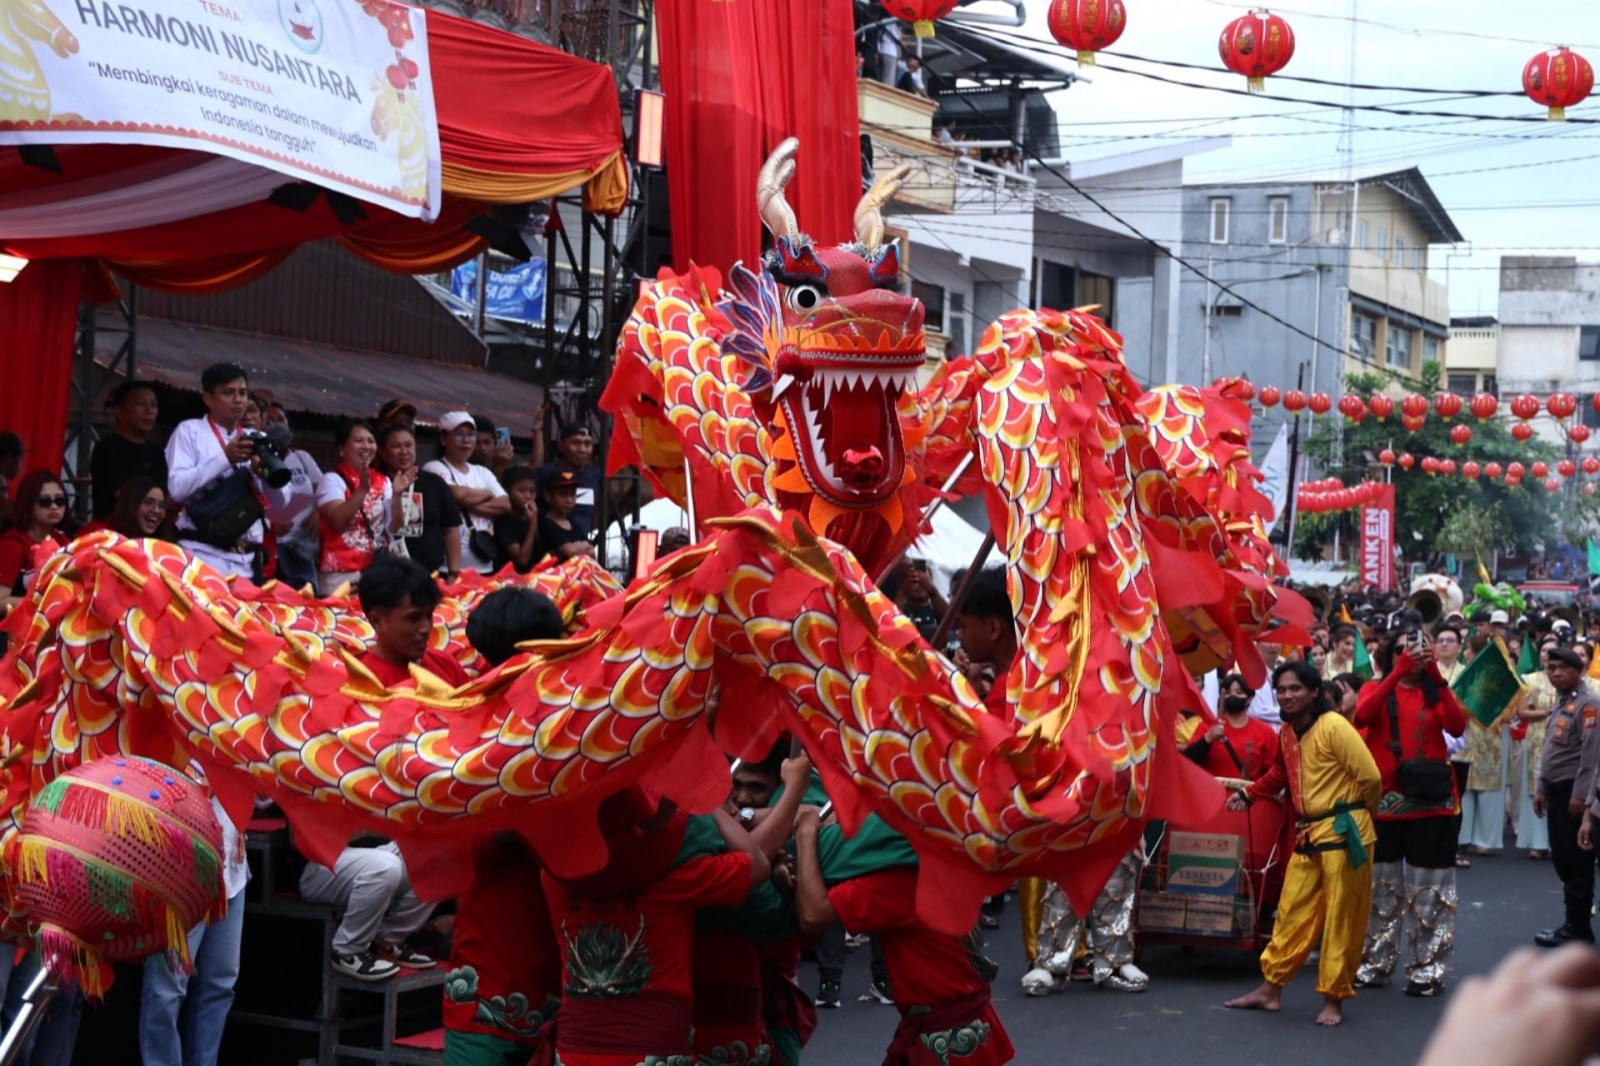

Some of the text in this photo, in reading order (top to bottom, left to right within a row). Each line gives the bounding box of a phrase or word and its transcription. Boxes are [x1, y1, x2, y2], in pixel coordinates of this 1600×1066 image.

[75, 0, 362, 104] HARMONI NUSANTARA
[218, 70, 242, 86] SUB
[196, 80, 272, 115] keragaman
[273, 104, 310, 128] dalam
[311, 118, 378, 153] mewujudkan
[200, 106, 264, 137] Indonesia
[1364, 507, 1379, 594] ANKEN
